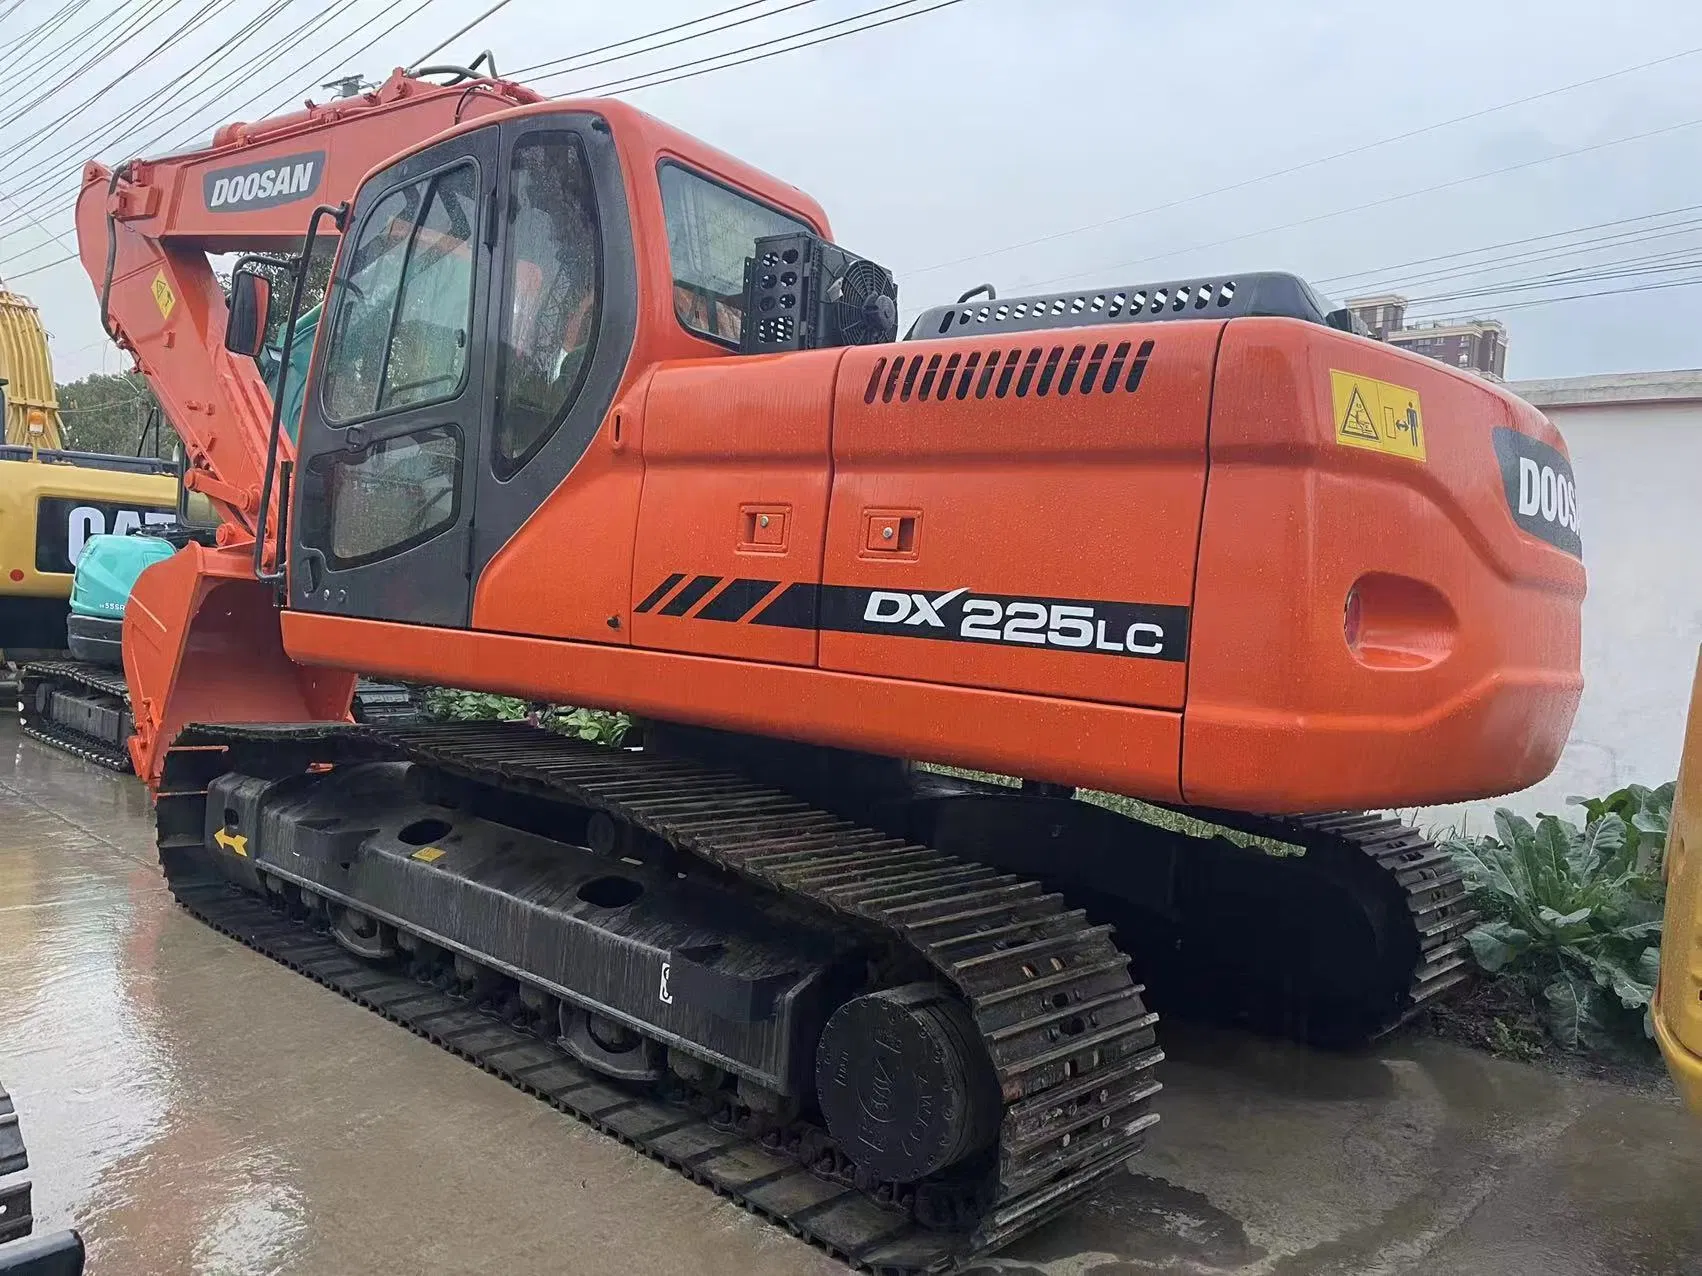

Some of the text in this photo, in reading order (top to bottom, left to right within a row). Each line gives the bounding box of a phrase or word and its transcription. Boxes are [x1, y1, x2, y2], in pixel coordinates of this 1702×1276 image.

[210, 161, 314, 207] DOOSAN
[1518, 456, 1580, 536] DOOS
[863, 587, 1164, 655] DX 225LC
